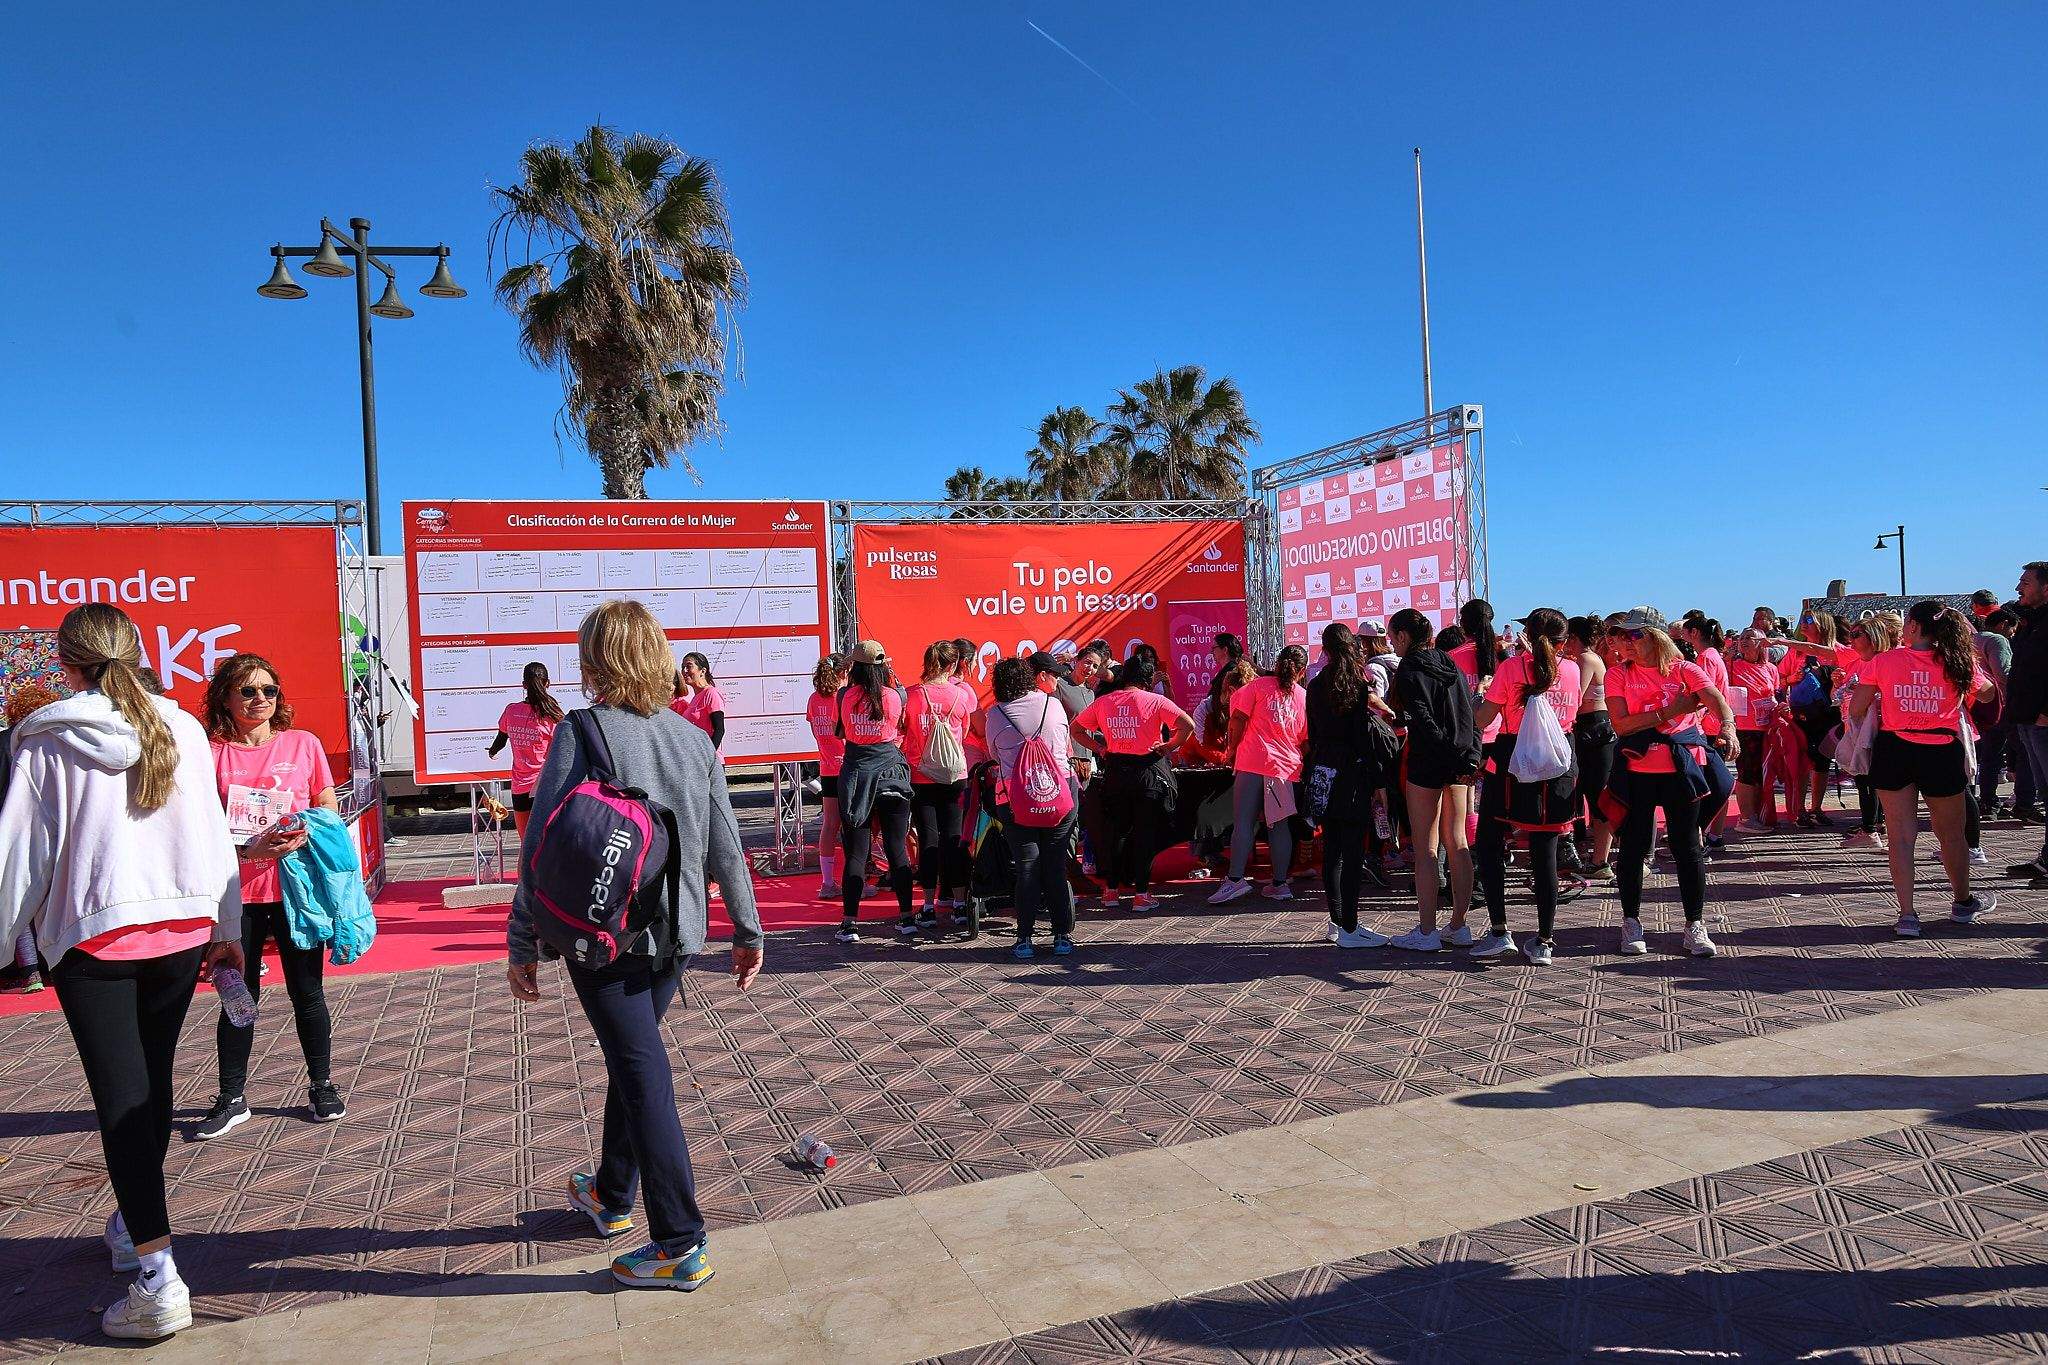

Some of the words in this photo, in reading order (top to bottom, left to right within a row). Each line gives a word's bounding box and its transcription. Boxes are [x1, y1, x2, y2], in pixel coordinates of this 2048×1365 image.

[507, 514, 585, 527] Clasificación
[589, 514, 604, 526] de
[607, 514, 619, 526] la
[621, 514, 667, 526] Carrera
[670, 514, 684, 526] de
[687, 514, 699, 526] la
[702, 514, 736, 528] Mujer
[771, 522, 813, 532] Santander
[867, 547, 937, 567] pulseras
[890, 564, 938, 579] Rosas
[1187, 562, 1239, 573] Santander
[1013, 562, 1045, 586] Tu
[1054, 560, 1112, 592] pelo
[965, 589, 1026, 616] vale
[1035, 596, 1067, 614] un
[1076, 591, 1157, 612] tesoro
[1191, 624, 1202, 633] Tu
[1205, 623, 1226, 635] pelo
[1175, 635, 1196, 645] vale
[1199, 635, 1211, 644] un
[1911, 671, 1930, 685] TU
[1893, 684, 1946, 700] DORSAL
[818, 705, 827, 716] TU
[1117, 705, 1130, 717] TU
[1900, 698, 1939, 714] SUMA
[1106, 716, 1141, 728] DORSAL
[854, 724, 882, 736] SUMA
[1112, 728, 1137, 739] SUMA
[587, 828, 632, 924] nabaiji
